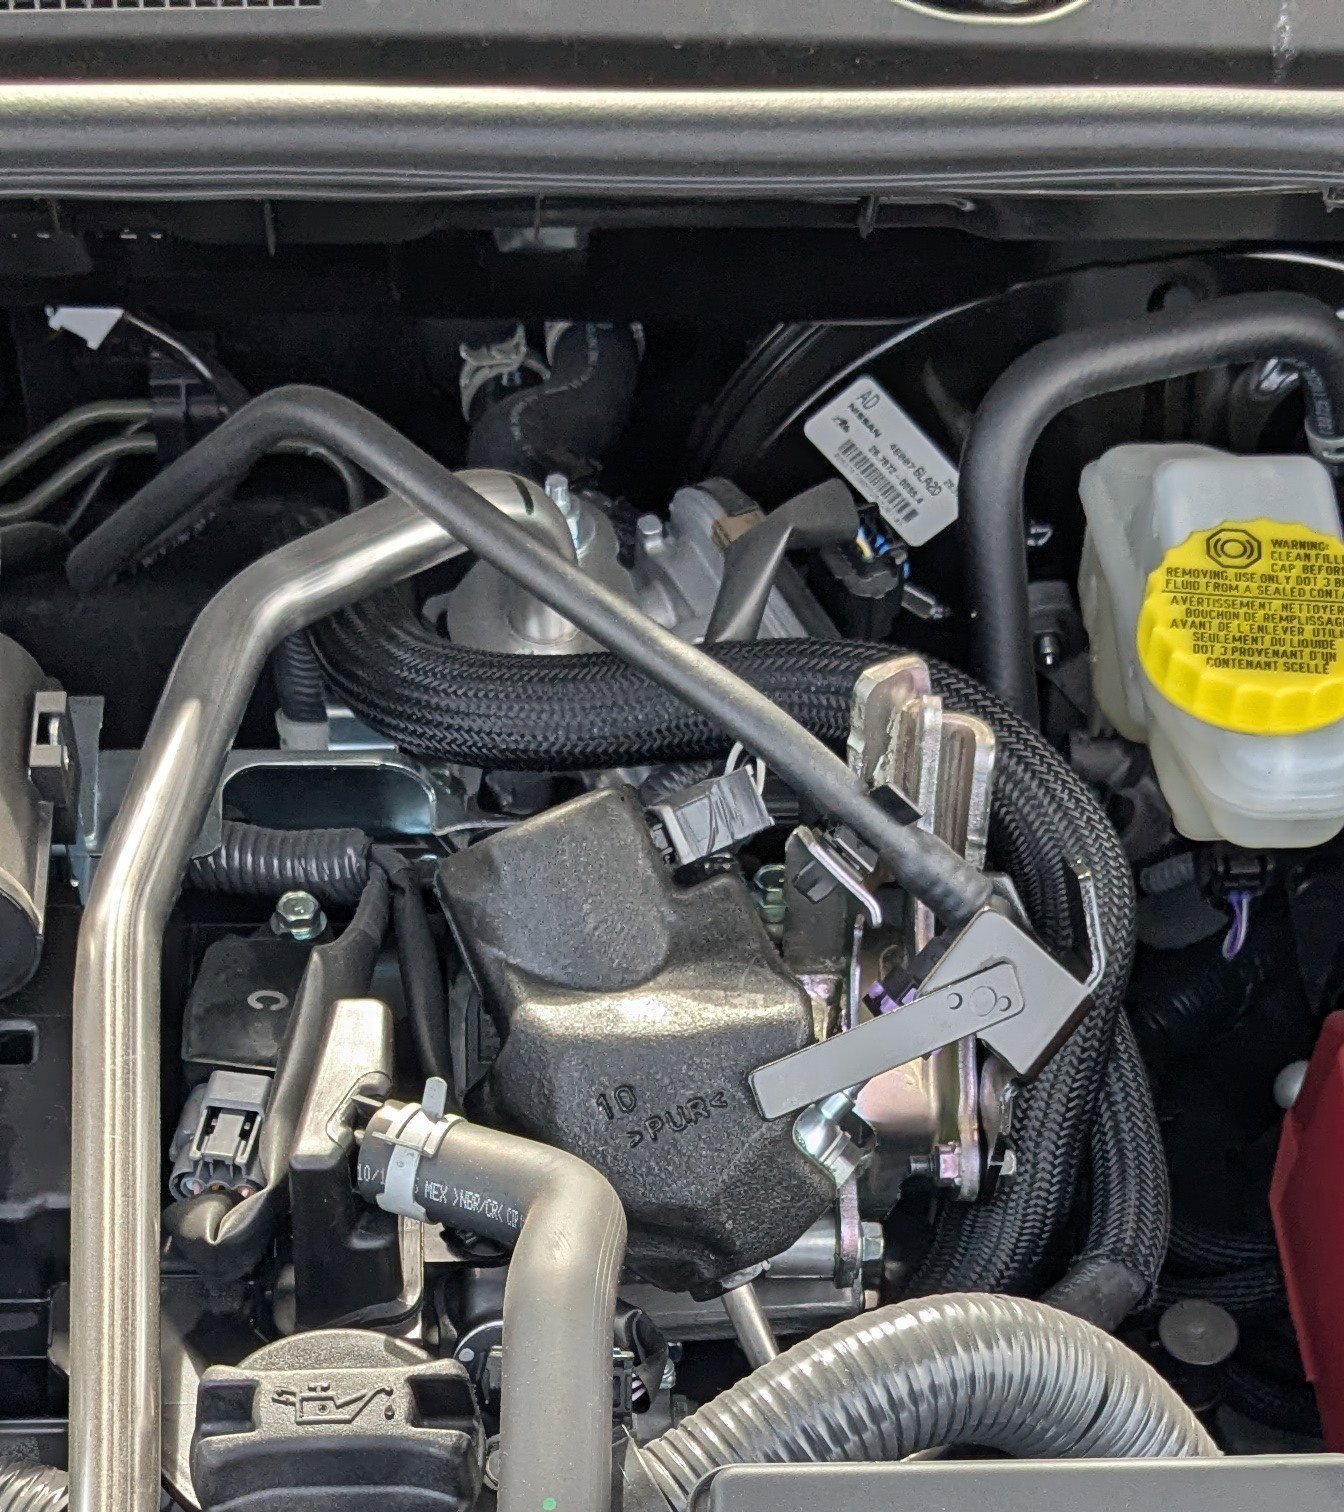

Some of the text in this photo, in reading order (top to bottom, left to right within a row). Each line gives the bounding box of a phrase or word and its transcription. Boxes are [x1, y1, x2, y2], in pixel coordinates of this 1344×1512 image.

[857, 390, 881, 410] AD
[848, 403, 883, 438] NISSAN
[1270, 551, 1314, 563] CLEAN
[1271, 563, 1295, 574] CAP
[1235, 572, 1257, 583] USE
[1260, 573, 1291, 586] ONLY
[1295, 575, 1318, 586] DOT
[1323, 576, 1330, 587] 3
[1165, 579, 1200, 591] FLUID
[1205, 581, 1239, 594] FROM
[1243, 583, 1252, 594] A
[1257, 584, 1306, 598] SEALED
[1185, 607, 1240, 622] BOUCHON
[1244, 611, 1258, 623] DE
[1281, 602, 1344, 616] NETTOYER
[1169, 618, 1214, 631] AVANT
[1218, 620, 1232, 632] DE
[1193, 632, 1337, 651] SEULEMENT DU LIQUIDE
[1192, 644, 1215, 655] DOT
[1220, 645, 1227, 656] 3
[1231, 647, 1304, 660] PROVENANT
[1206, 657, 1278, 671] CONTENANT
[596, 1083, 638, 1120] 10
[423, 1180, 450, 1205] MEX
